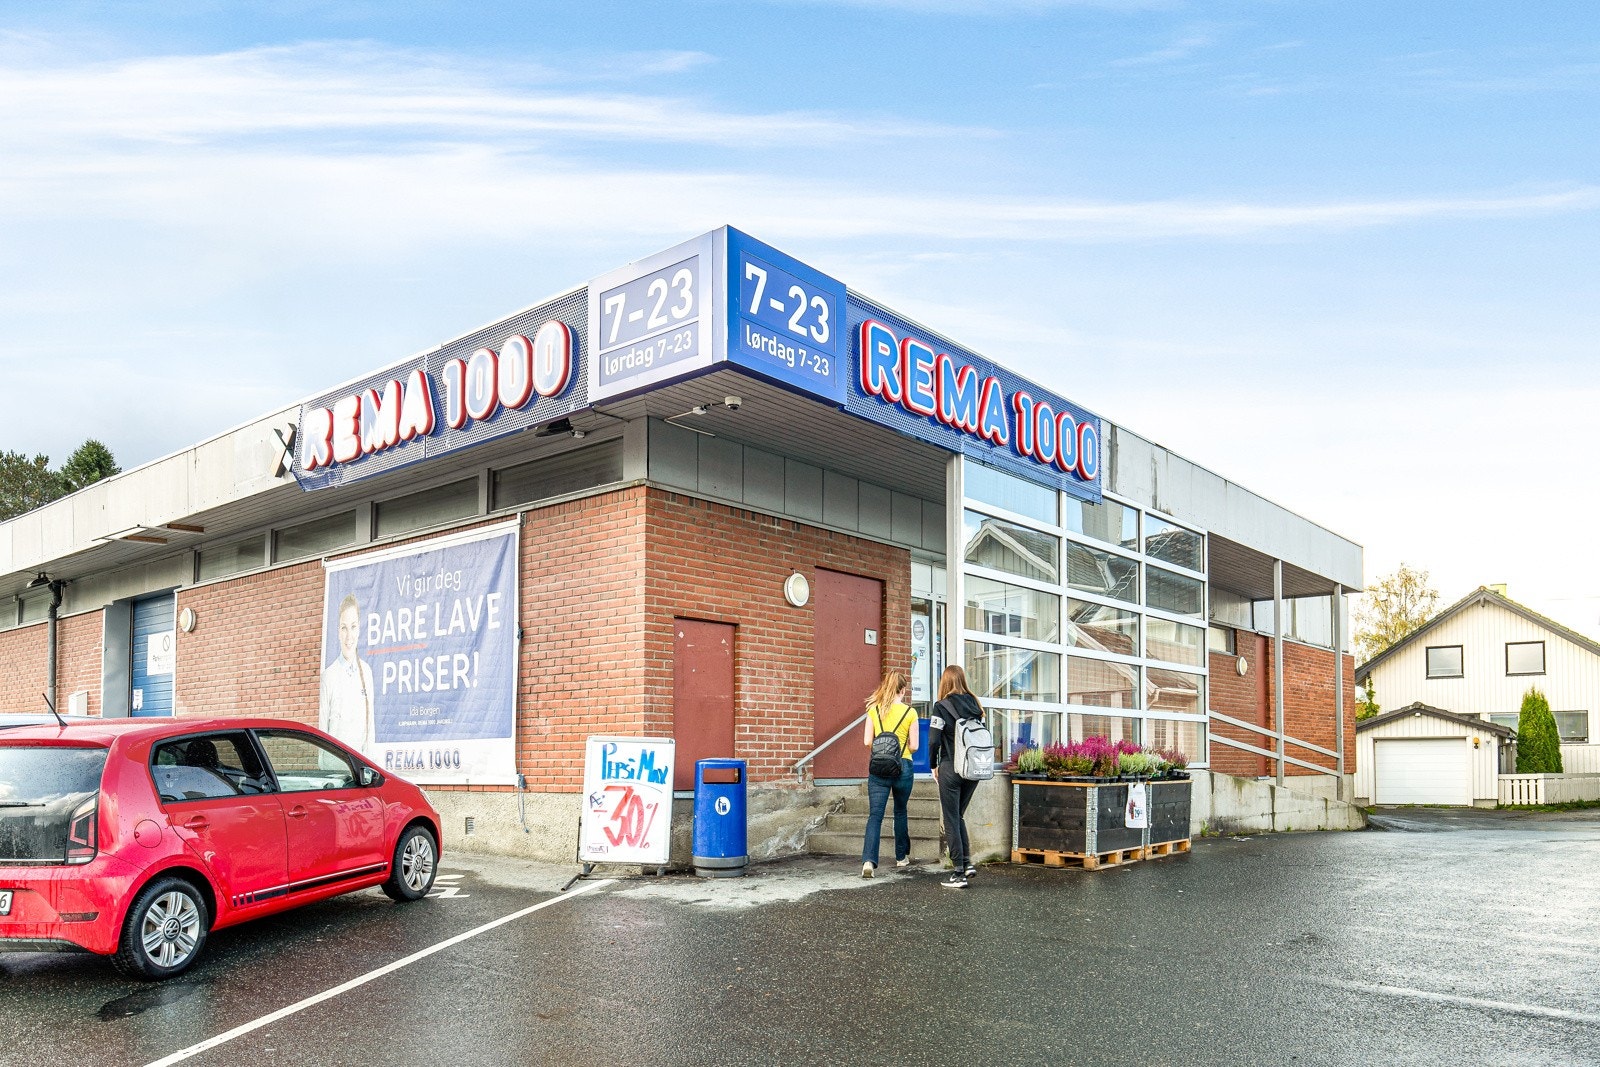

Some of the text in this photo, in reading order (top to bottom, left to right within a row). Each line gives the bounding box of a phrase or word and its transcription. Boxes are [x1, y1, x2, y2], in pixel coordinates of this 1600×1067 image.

[604, 268, 693, 344] 7-23
[745, 261, 830, 345] 7-23
[604, 330, 693, 376] lørdag 7-23
[745, 324, 830, 377] lørdag 7-23
[300, 319, 573, 472] REMA 1000
[859, 318, 1098, 481] REMA 1000
[396, 567, 462, 598] Vi gir deg
[367, 591, 502, 646] BARE LAVE
[382, 651, 480, 695] PRISER!
[385, 748, 461, 770] REMA 1000
